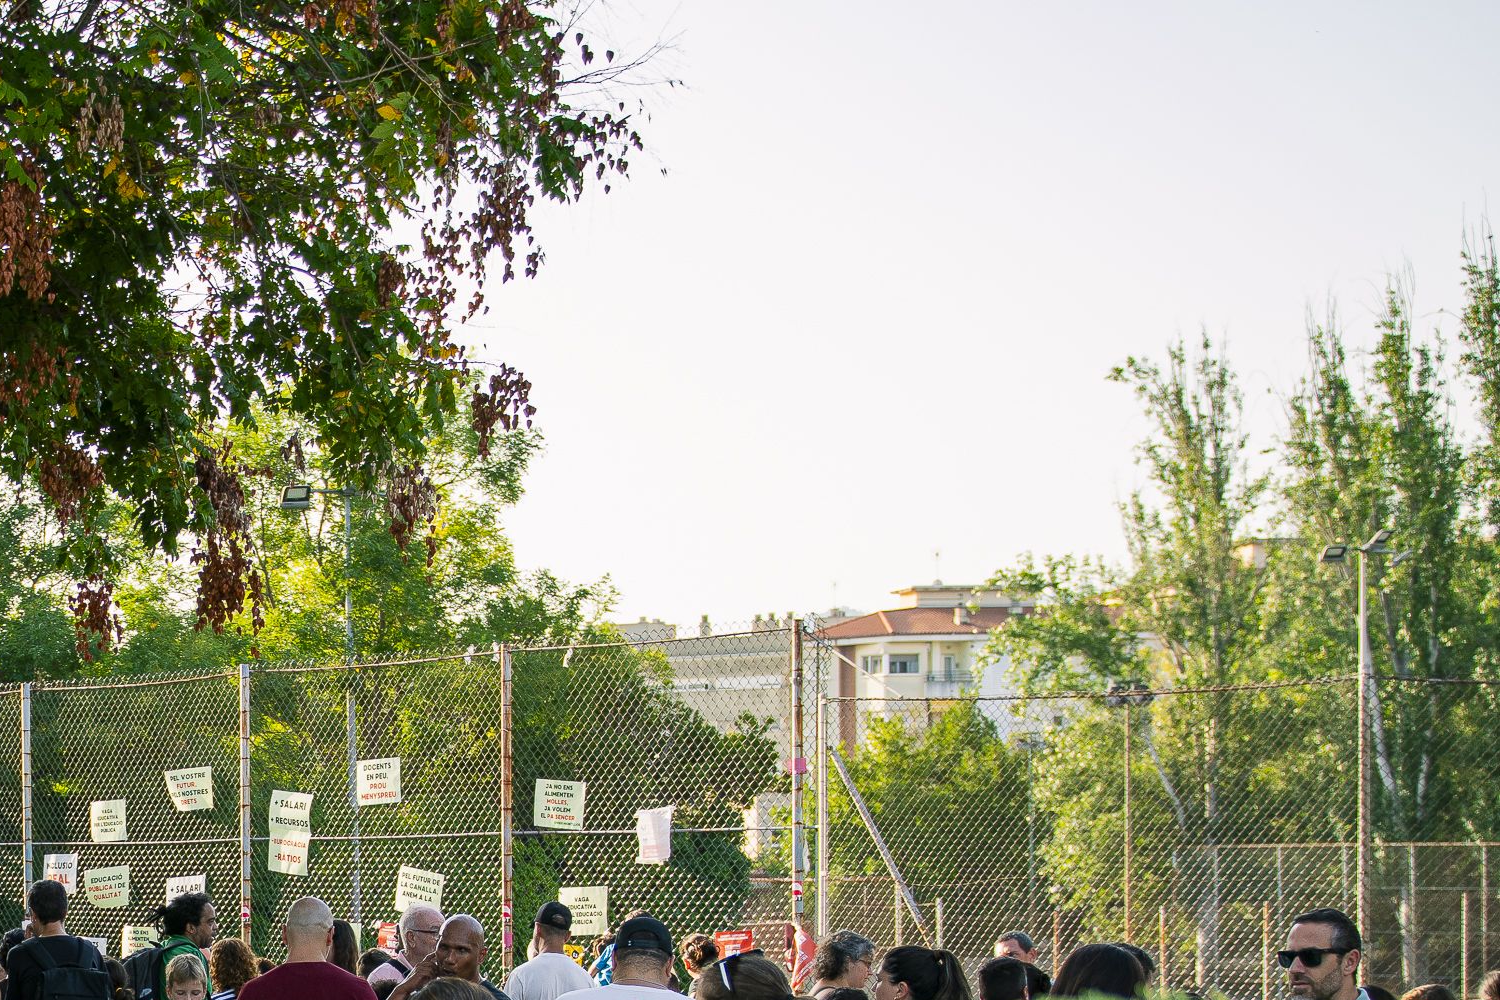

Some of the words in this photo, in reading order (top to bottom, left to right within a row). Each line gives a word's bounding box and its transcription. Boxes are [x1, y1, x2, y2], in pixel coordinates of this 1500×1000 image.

[181, 772, 206, 780] VOSTRE
[370, 782, 387, 790] PROU
[181, 788, 209, 797] NOSTRES
[361, 791, 397, 800] MENYSPREU
[544, 791, 574, 799] ALIMENTEN
[280, 799, 307, 811] SALARI
[275, 816, 309, 828] RECURSOS
[401, 872, 411, 880] PEL
[412, 874, 431, 883] FUTUR
[93, 891, 122, 901] QUALITAT
[402, 890, 418, 899] ANEM
